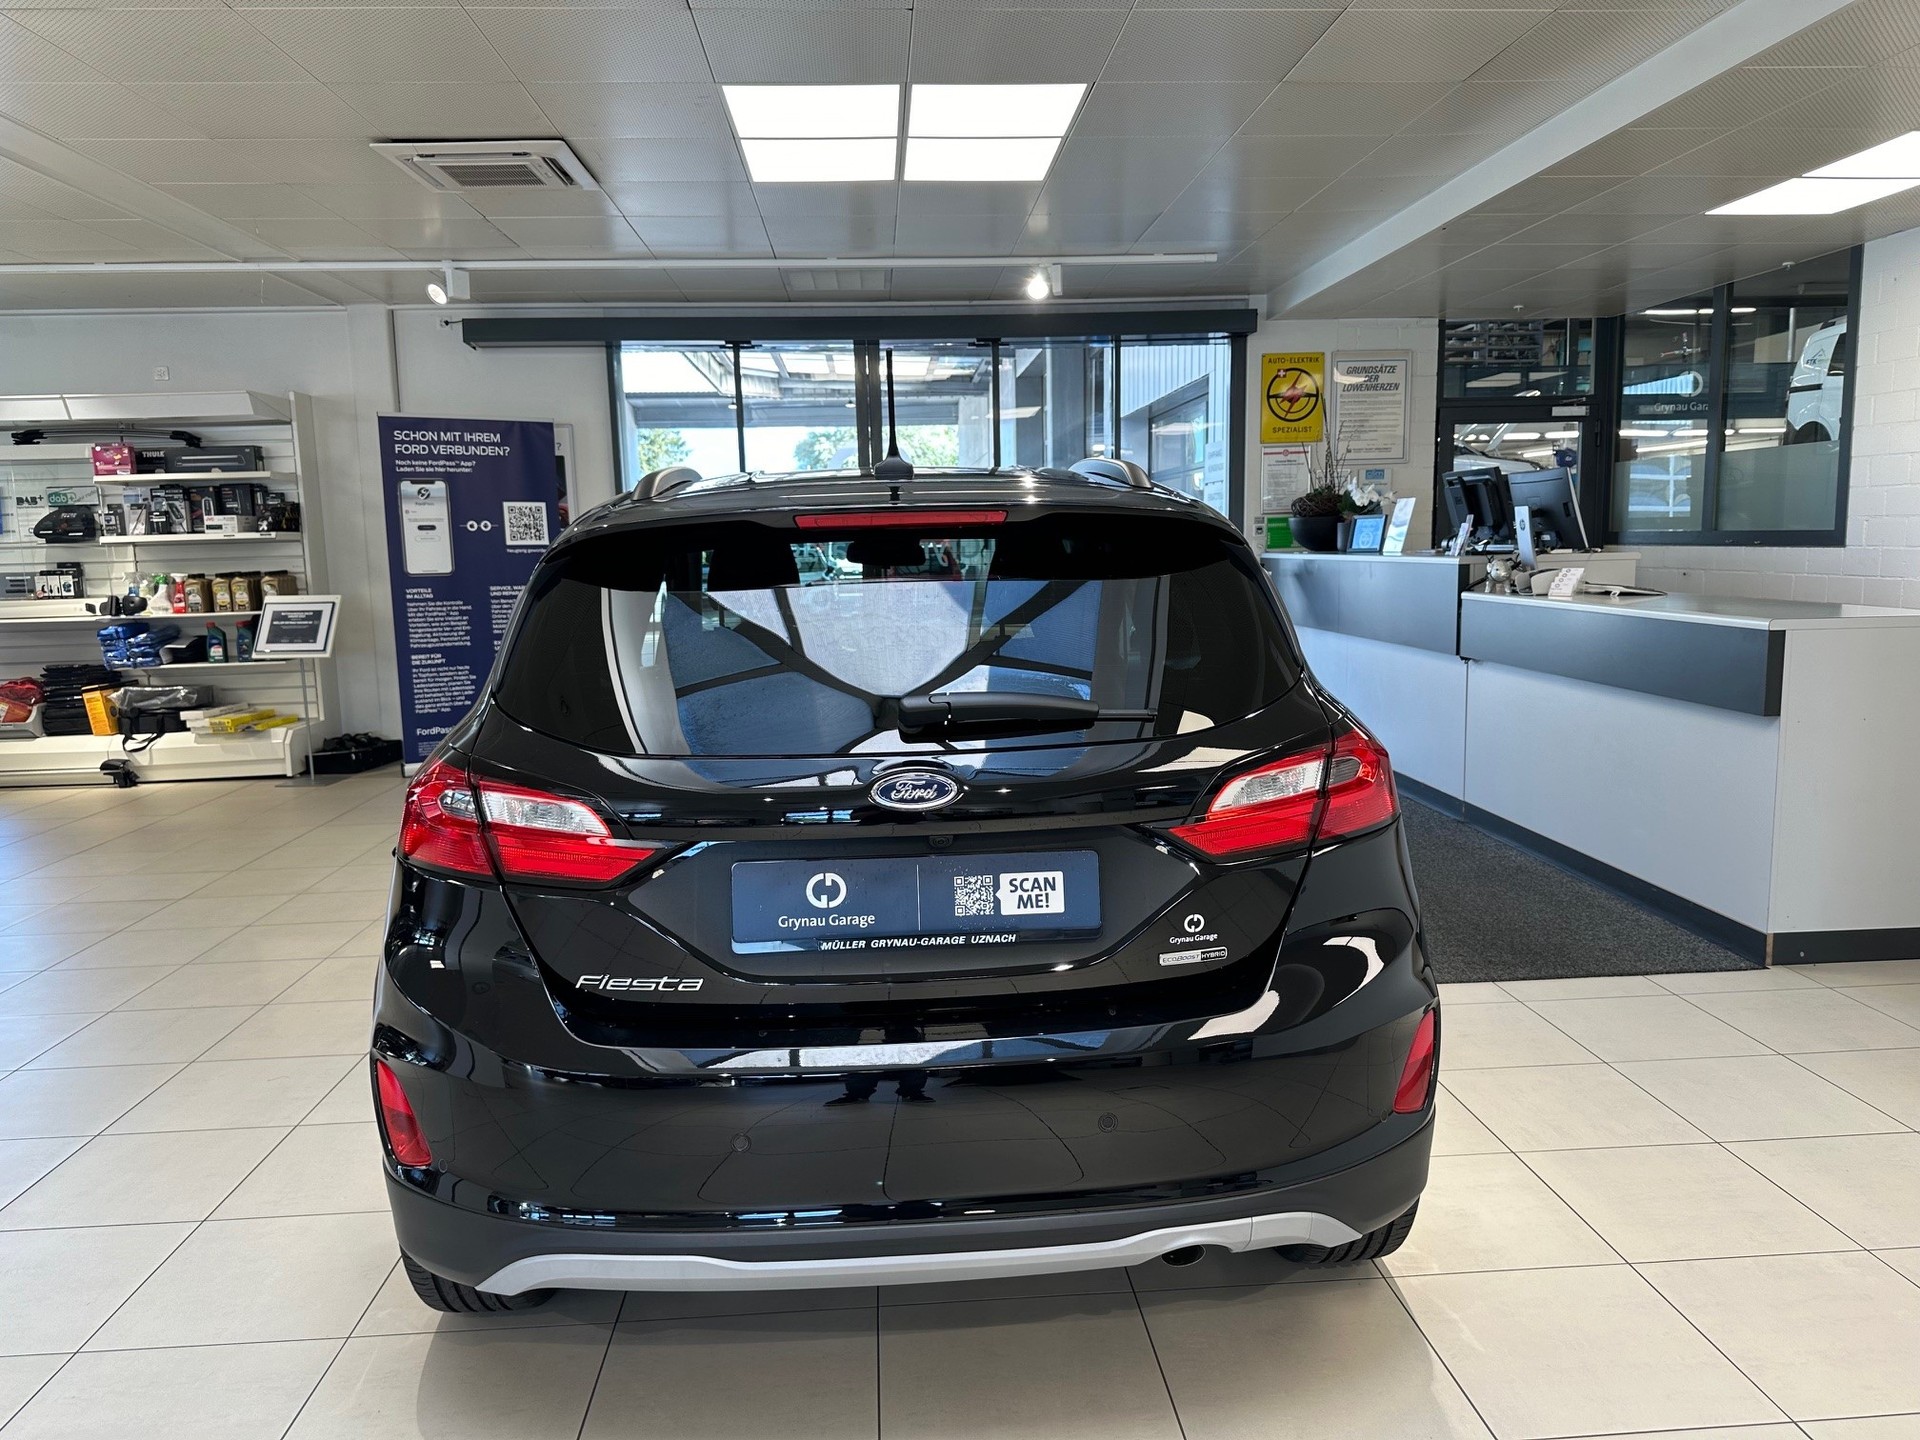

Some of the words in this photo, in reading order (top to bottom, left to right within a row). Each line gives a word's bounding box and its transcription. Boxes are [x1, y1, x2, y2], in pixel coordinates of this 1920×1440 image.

[1346, 364, 1397, 374] GRUNDSÄTZE
[1654, 402, 1688, 414] Grynau
[394, 430, 438, 441] SCHON
[440, 432, 461, 442] MIT
[464, 432, 500, 442] IHREM
[395, 444, 428, 454] FORD
[431, 445, 510, 456] VERBUNDEN?
[16, 495, 44, 506] DAB+
[890, 780, 938, 800] Ford
[1008, 876, 1056, 893] SCAN
[1016, 893, 1050, 910] ME!
[778, 915, 826, 930] Grynau
[828, 914, 876, 928] Garage
[820, 939, 866, 950] MÜLLER
[870, 936, 966, 948] GRYNAU-GARAGE
[970, 934, 1016, 944] UZNACH
[1170, 936, 1194, 944] Grynau
[1194, 934, 1218, 942] Garage
[1202, 950, 1226, 959] HYBRID
[575, 974, 704, 991] Fiesta
